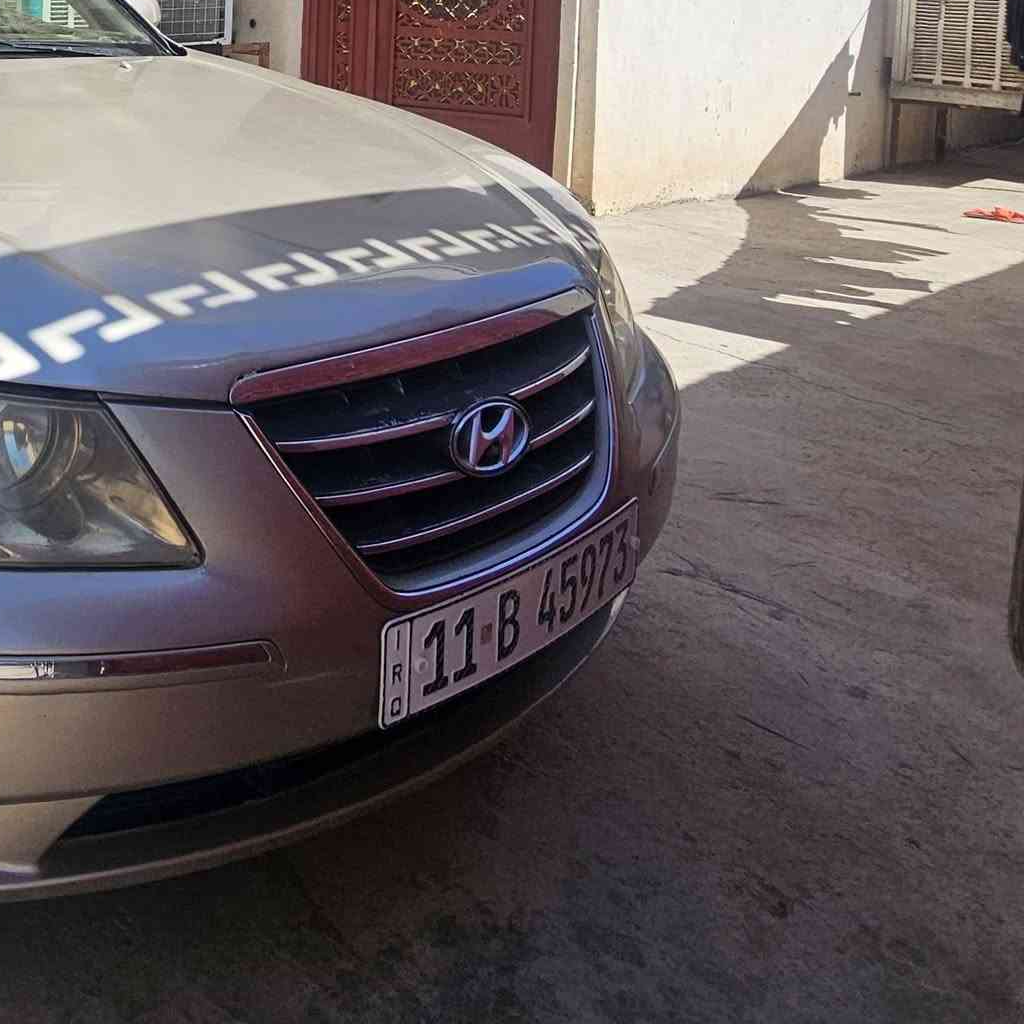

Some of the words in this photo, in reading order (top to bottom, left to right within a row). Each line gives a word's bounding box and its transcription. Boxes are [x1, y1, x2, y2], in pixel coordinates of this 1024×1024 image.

[390, 629, 403, 718] IRQ
[422, 607, 477, 696] 11
[497, 588, 521, 662] B
[537, 519, 630, 633] 45973
